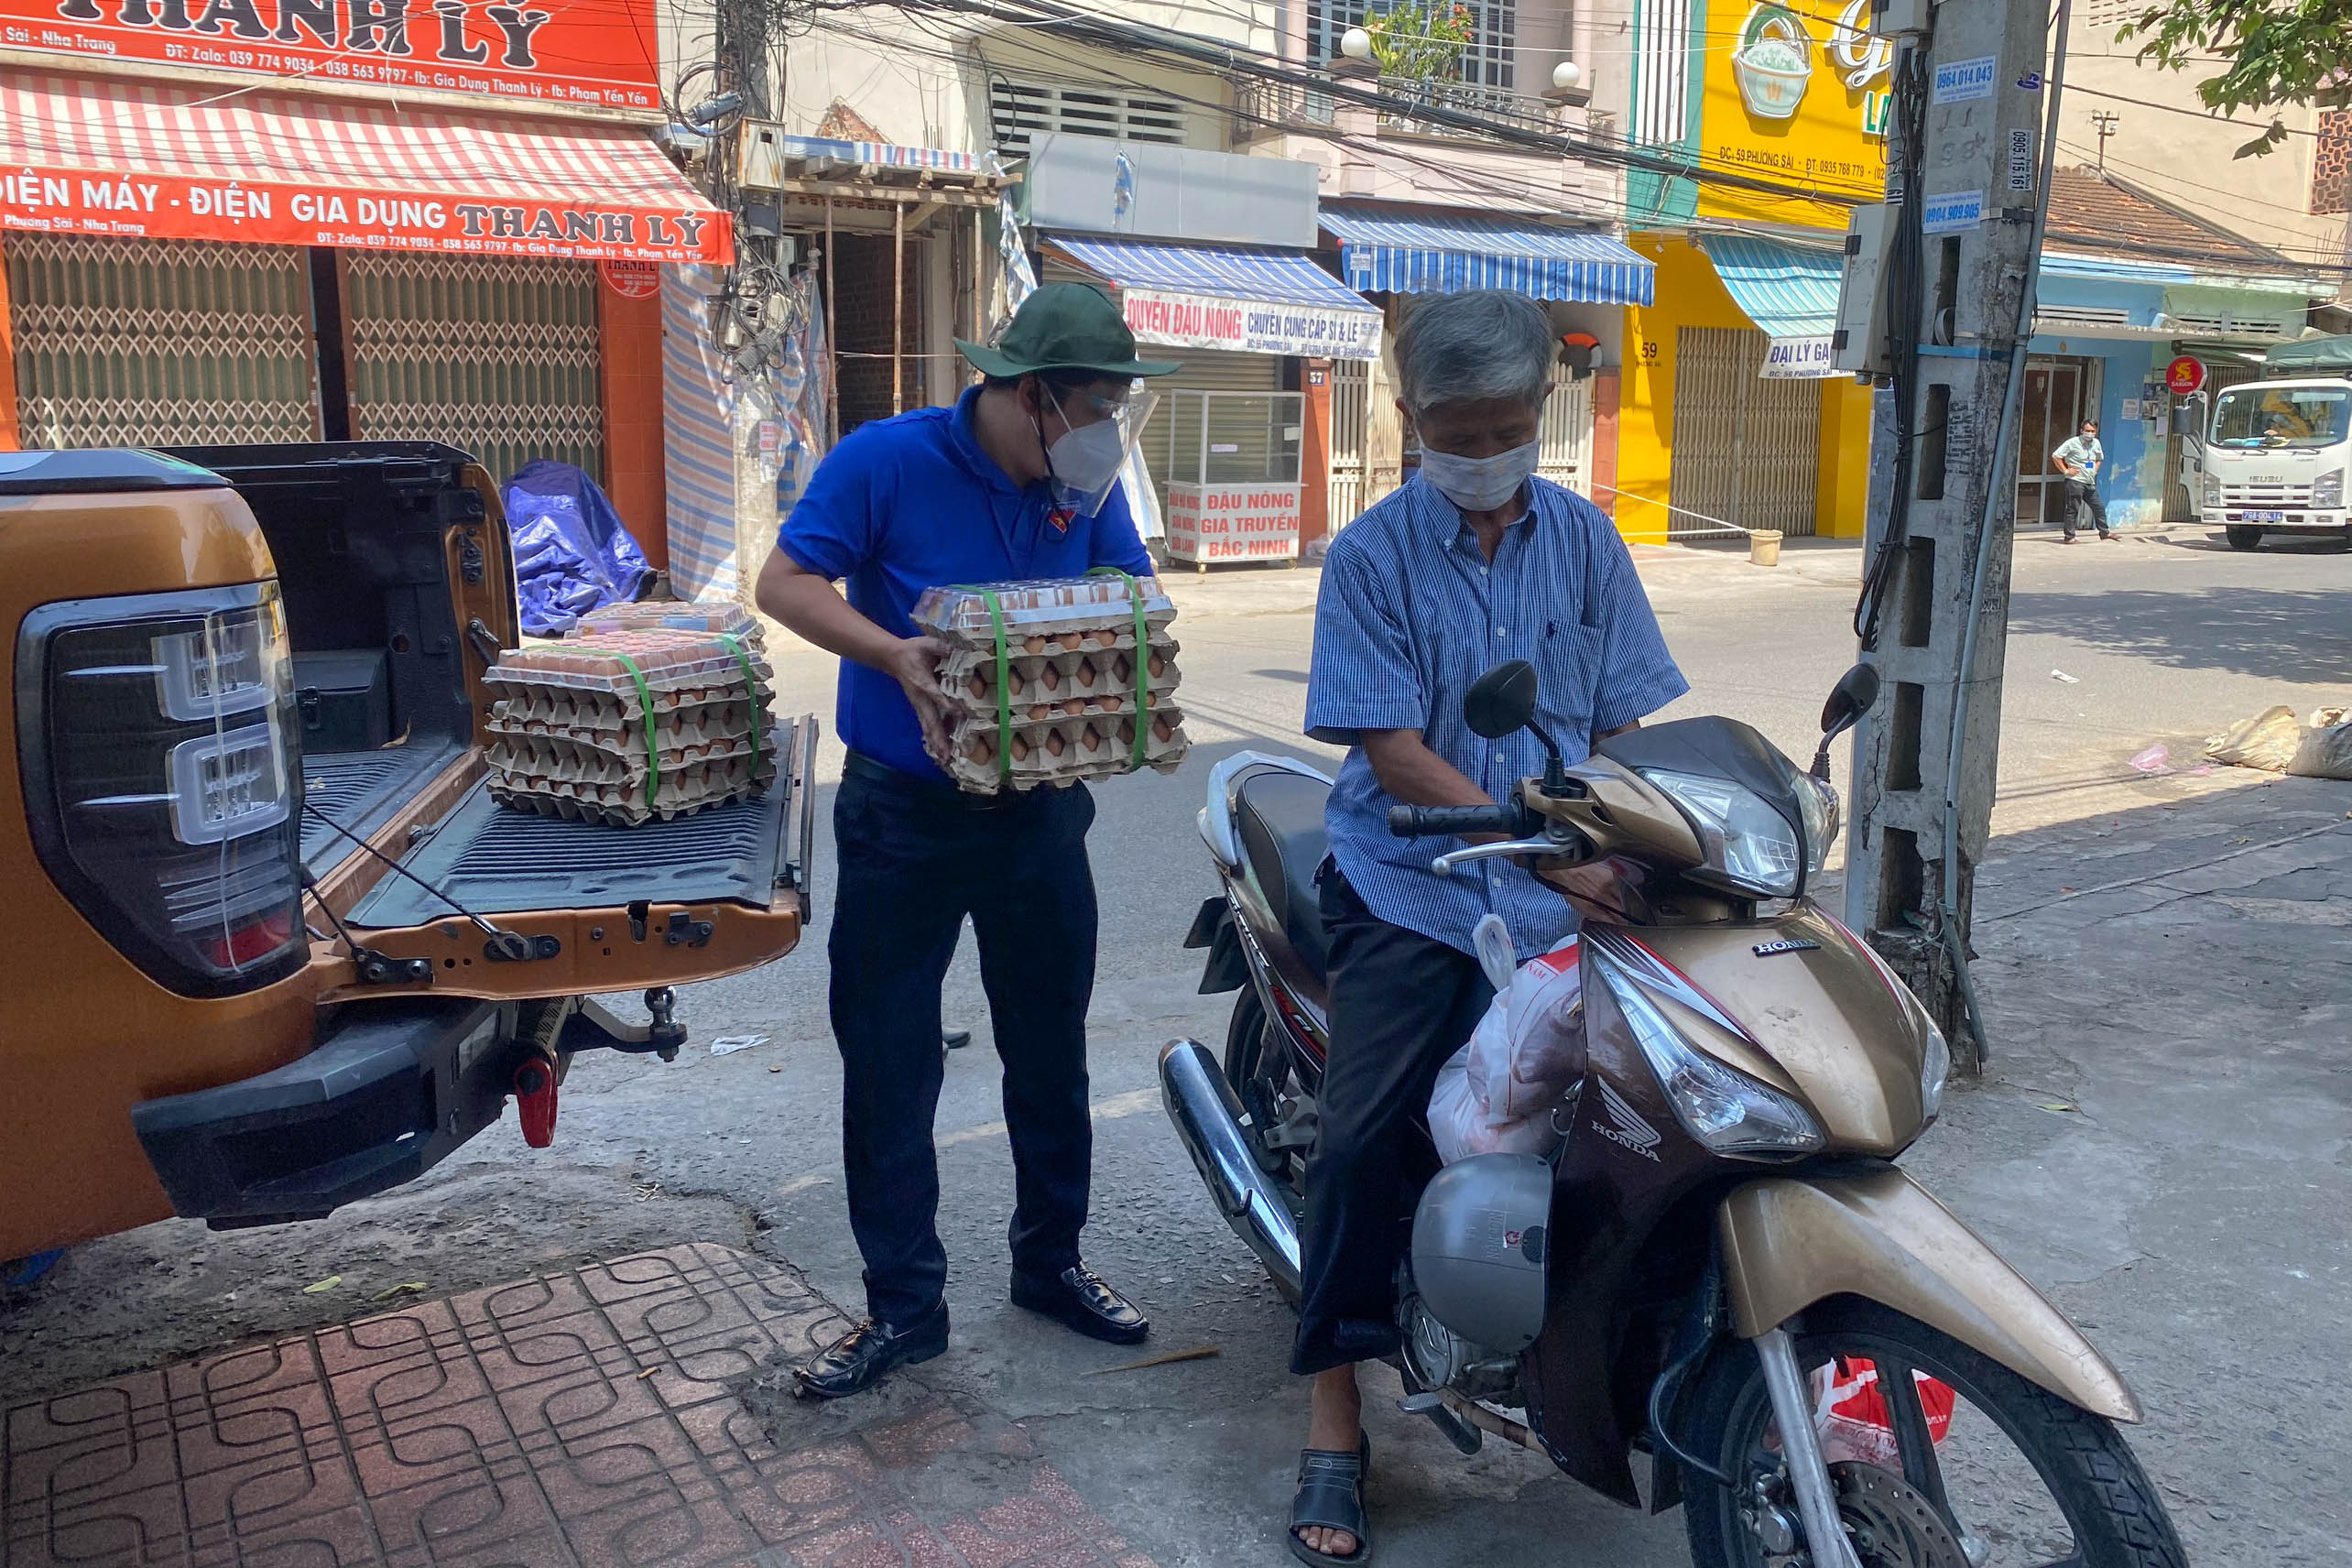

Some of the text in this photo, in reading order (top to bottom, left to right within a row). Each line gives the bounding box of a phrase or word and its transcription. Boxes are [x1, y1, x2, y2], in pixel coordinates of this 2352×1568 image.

[41, 30, 72, 47] Nha
[74, 34, 116, 54] Trang
[165, 43, 188, 59] ĐT:
[192, 47, 226, 63] Zalo:
[229, 50, 253, 65] 039
[257, 53, 280, 69] 774
[284, 56, 315, 72] 9034
[326, 60, 349, 75] 038
[353, 64, 375, 79] 563
[378, 66, 407, 82] 9797
[433, 73, 455, 87] Gia
[459, 75, 489, 93] Dụng
[492, 78, 528, 94] Thanh
[570, 86, 600, 103] Phạm
[603, 88, 624, 103] Yến
[626, 91, 648, 104] Yến
[1937, 65, 1993, 89] 0964.014.043
[1747, 150, 1779, 167] PHƯƠNG
[1820, 160, 1836, 174] 0935
[1838, 162, 1850, 176] 768
[1852, 165, 1864, 177] 779
[2011, 131, 2026, 191] 0905.115.161
[81, 174, 158, 212] MÁY
[189, 181, 272, 224] ĐIỆN
[290, 193, 350, 224] GIA
[358, 196, 447, 234] DỤNG
[454, 203, 636, 245] THANH
[646, 209, 708, 247] LÝ
[82, 219, 108, 231] Nha
[111, 221, 145, 235] Trang
[389, 236, 408, 246] 774
[464, 240, 482, 250] 563
[485, 241, 507, 252] 9797
[528, 243, 546, 253] Gia
[575, 245, 604, 256] Thanh
[1173, 299, 1202, 343] ĐẬU
[1205, 300, 1242, 340] NÓNG
[1284, 316, 1306, 338] CUNG
[1339, 322, 1345, 342] &
[1641, 343, 1657, 358] 59
[1769, 340, 1832, 367] ĐẠI LÝ GẠ
[1310, 372, 1323, 384] 57
[1207, 490, 1294, 513] ĐẬU NÓNG
[1201, 517, 1229, 533] GIA
[1209, 536, 1290, 557] BẮC NINH
[1591, 1120, 1661, 1163] HONDA
